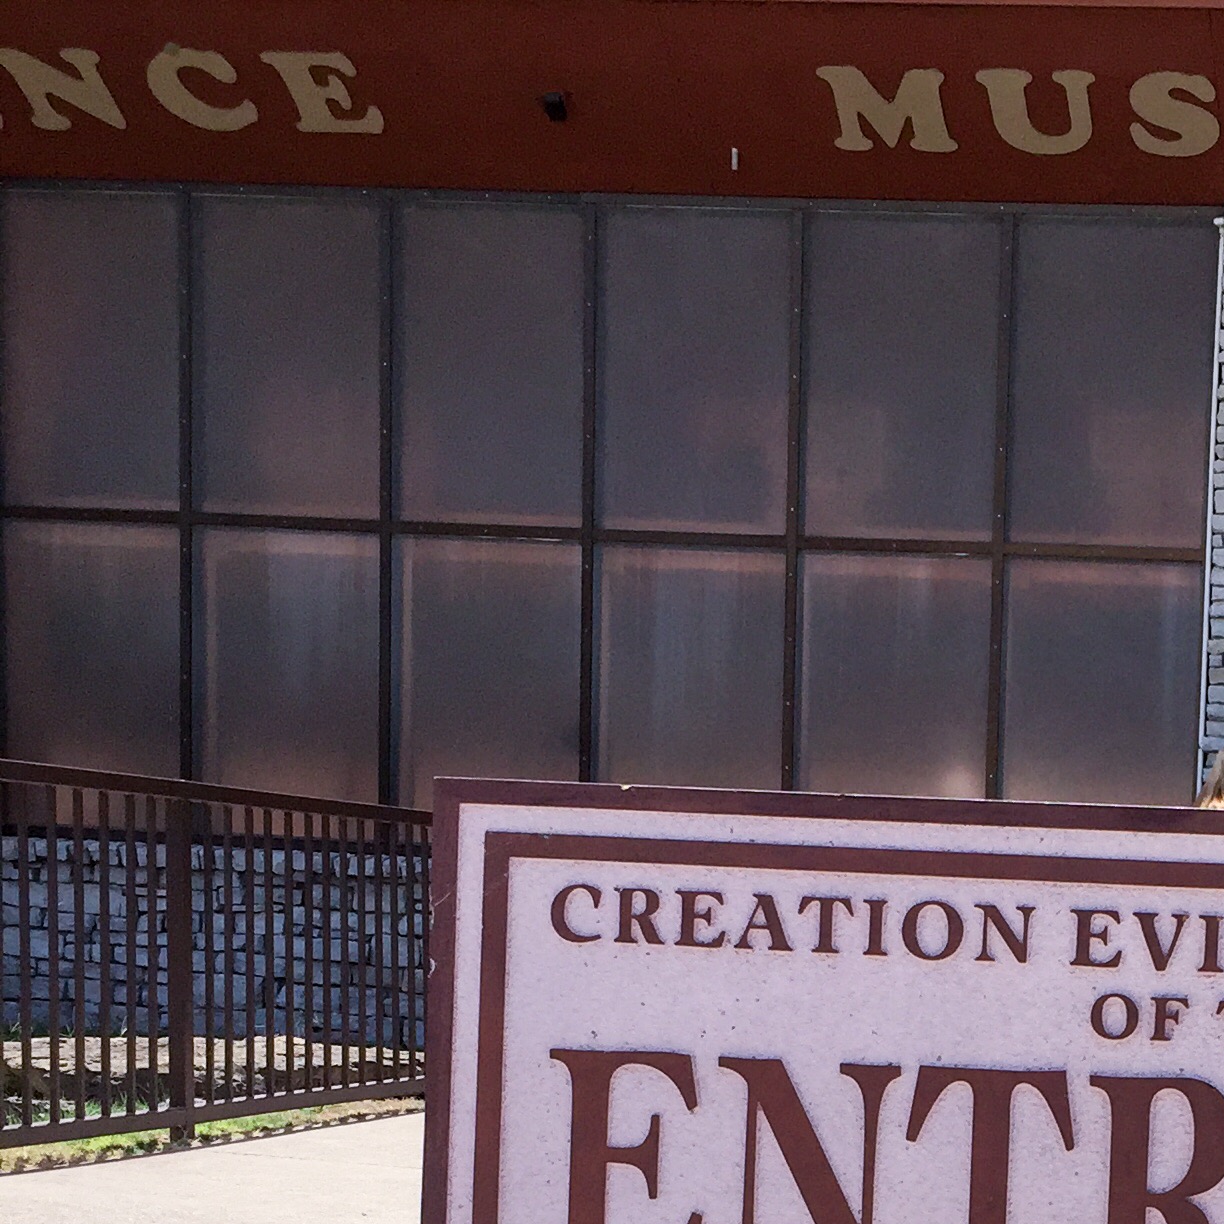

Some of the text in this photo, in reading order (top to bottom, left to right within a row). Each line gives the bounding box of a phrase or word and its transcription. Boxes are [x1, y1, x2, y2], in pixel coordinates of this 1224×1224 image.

[0, 42, 385, 134] NCE
[550, 882, 1038, 964] CREATION
[1090, 992, 1190, 1042] OF
